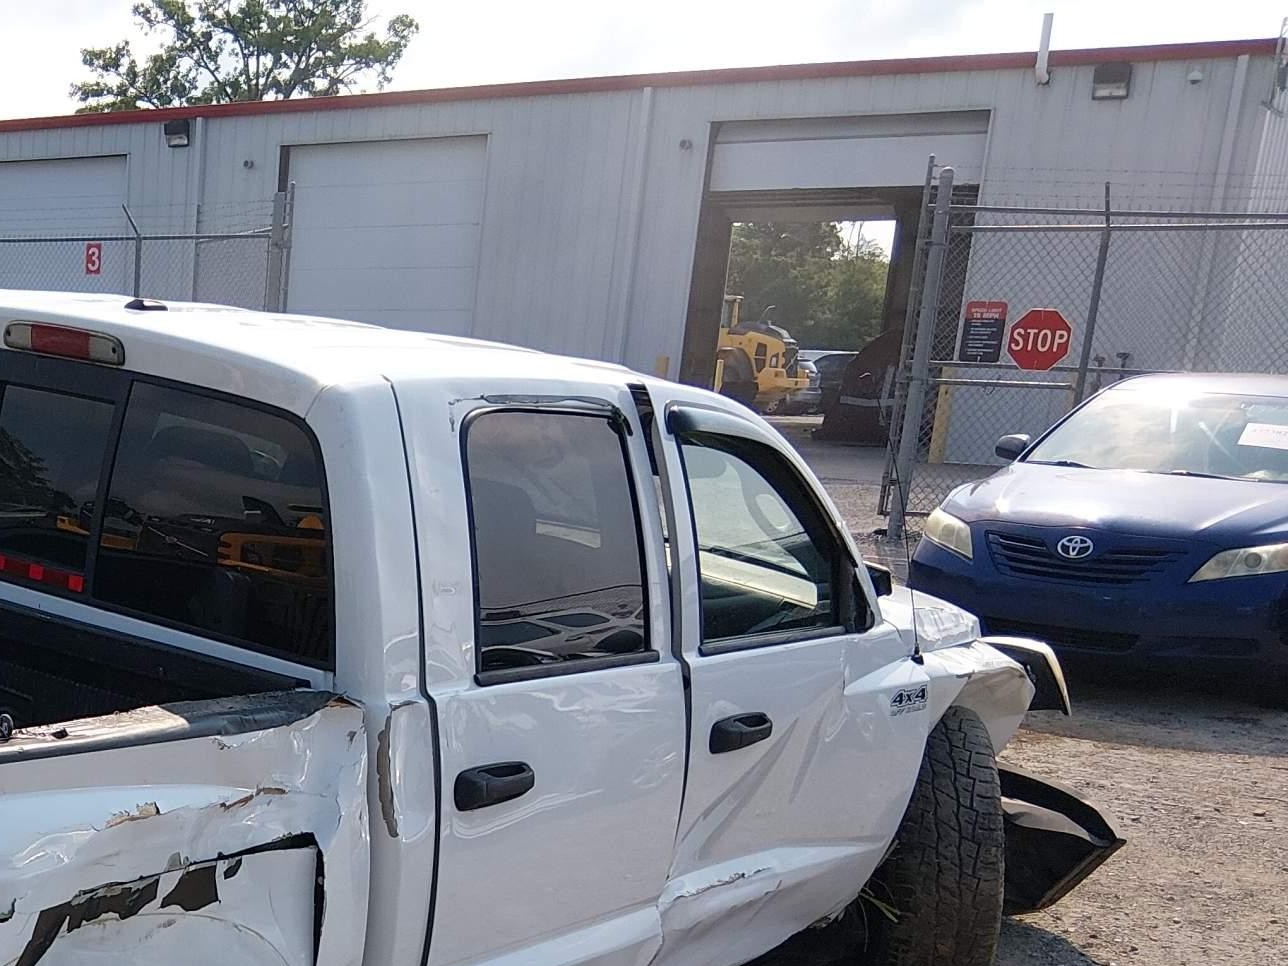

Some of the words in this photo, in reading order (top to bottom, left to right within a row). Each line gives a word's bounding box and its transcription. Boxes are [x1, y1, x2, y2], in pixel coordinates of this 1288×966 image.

[87, 247, 99, 271] 3
[1011, 328, 1068, 352] STOP
[890, 685, 928, 707] 4x4
